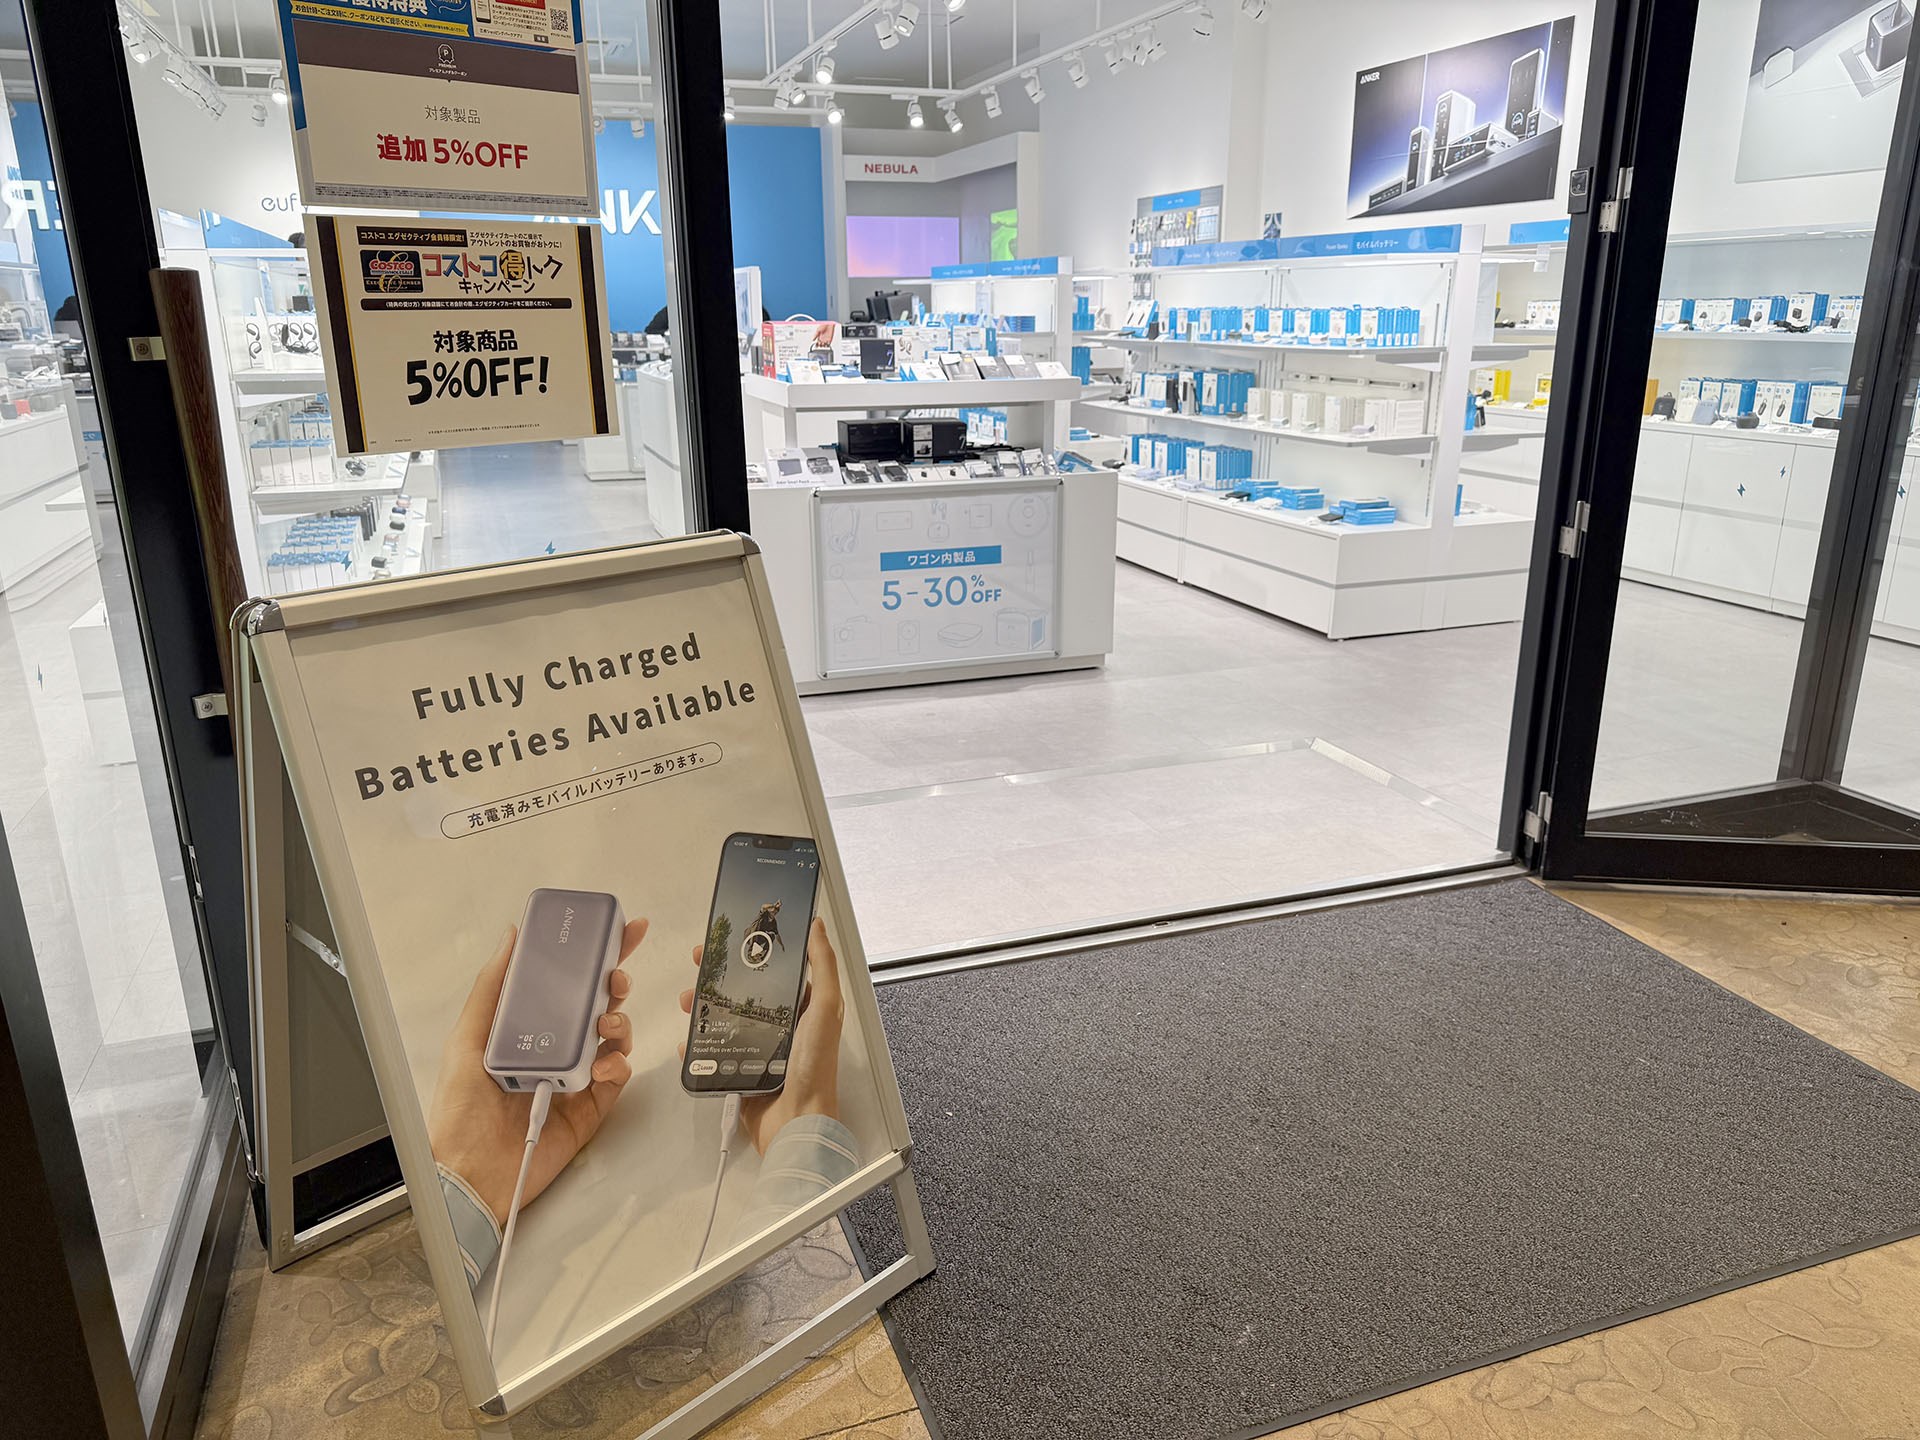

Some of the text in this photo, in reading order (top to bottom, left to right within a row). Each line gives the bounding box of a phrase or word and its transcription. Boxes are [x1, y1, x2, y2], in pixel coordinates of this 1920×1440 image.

[1359, 71, 1381, 84] ANKER
[424, 104, 481, 124] 対象製品
[376, 133, 529, 169] 追加 5%OFF
[864, 163, 919, 174] NEBULA
[360, 231, 386, 240] コストコ
[369, 259, 413, 271] COSTCO
[458, 278, 536, 295] キャンペーン
[433, 329, 518, 353] 対象商品
[406, 356, 550, 405] 5%OFF!
[907, 551, 976, 566] ワゴン内製品
[970, 589, 1002, 603] OFF
[412, 633, 702, 720] Fully Charged
[354, 679, 756, 800] Batteries Available
[467, 751, 707, 829] 充電済みモバイルバッテリーあります。
[558, 906, 575, 944] ANKER
